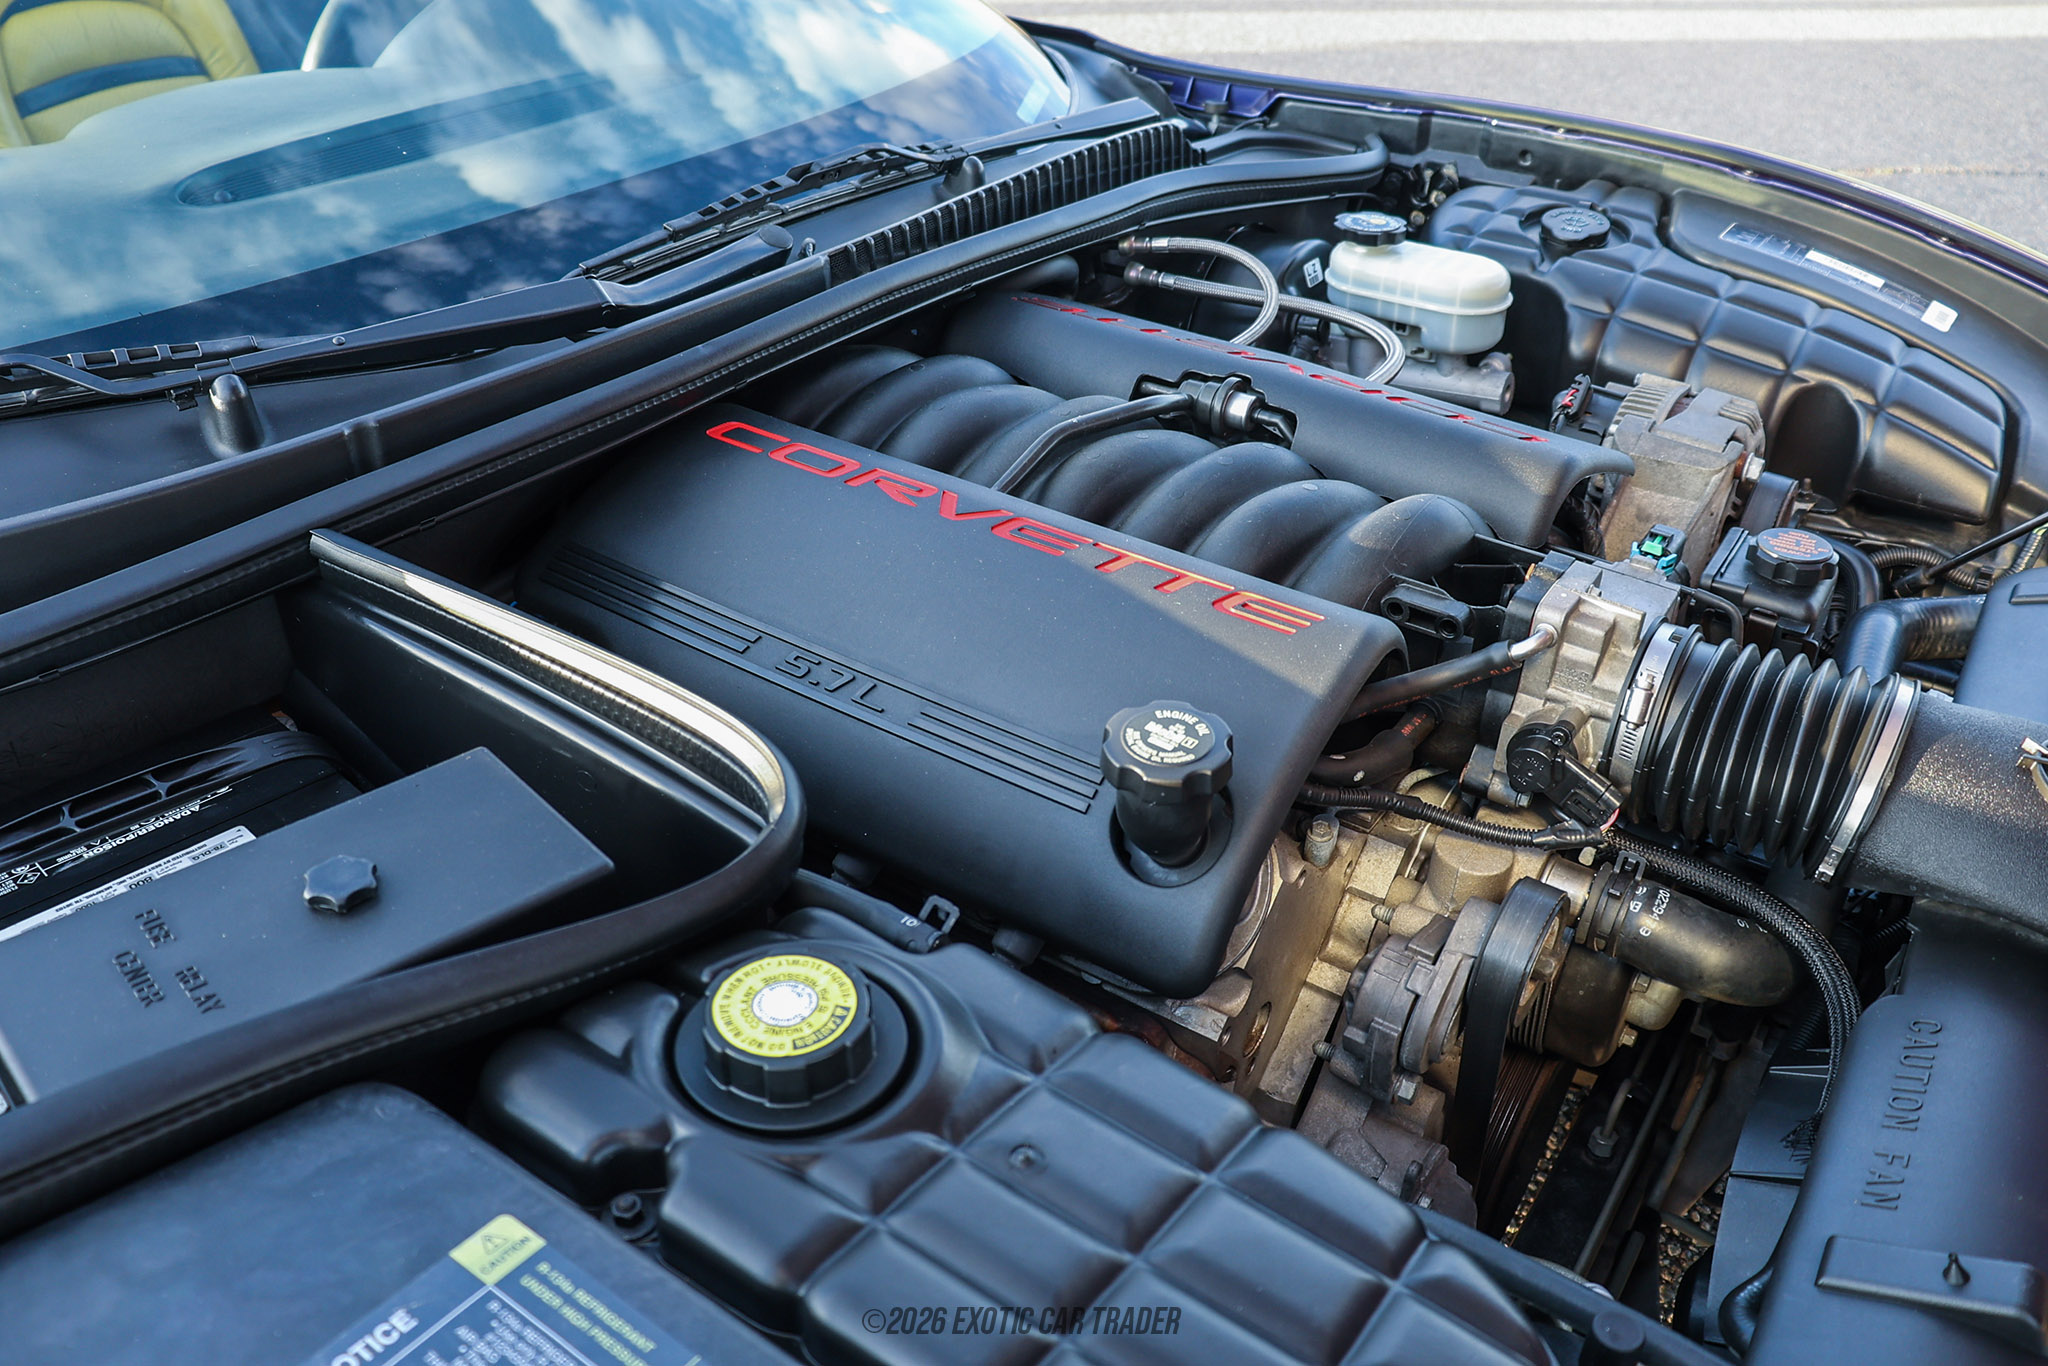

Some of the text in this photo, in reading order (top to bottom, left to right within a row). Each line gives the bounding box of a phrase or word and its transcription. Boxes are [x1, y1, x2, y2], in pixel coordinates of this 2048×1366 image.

[705, 421, 1325, 636] CORVETTE
[773, 652, 887, 716] 5.7L
[1154, 709, 1199, 725] ENGINE
[1194, 723, 1211, 737] OIL
[83, 808, 192, 860] DANGER/POISON
[129, 876, 154, 891] 800
[111, 950, 166, 1009] CENTER
[134, 908, 177, 949] FUSE
[174, 965, 227, 1015] RELAY
[1860, 1018, 1943, 1211] CAUTION FAN
[479, 1235, 532, 1275] CAUTION
[519, 1273, 565, 1310] UNDER
[558, 1303, 594, 1332] HIGH
[571, 1288, 657, 1353] REFRIGERANT
